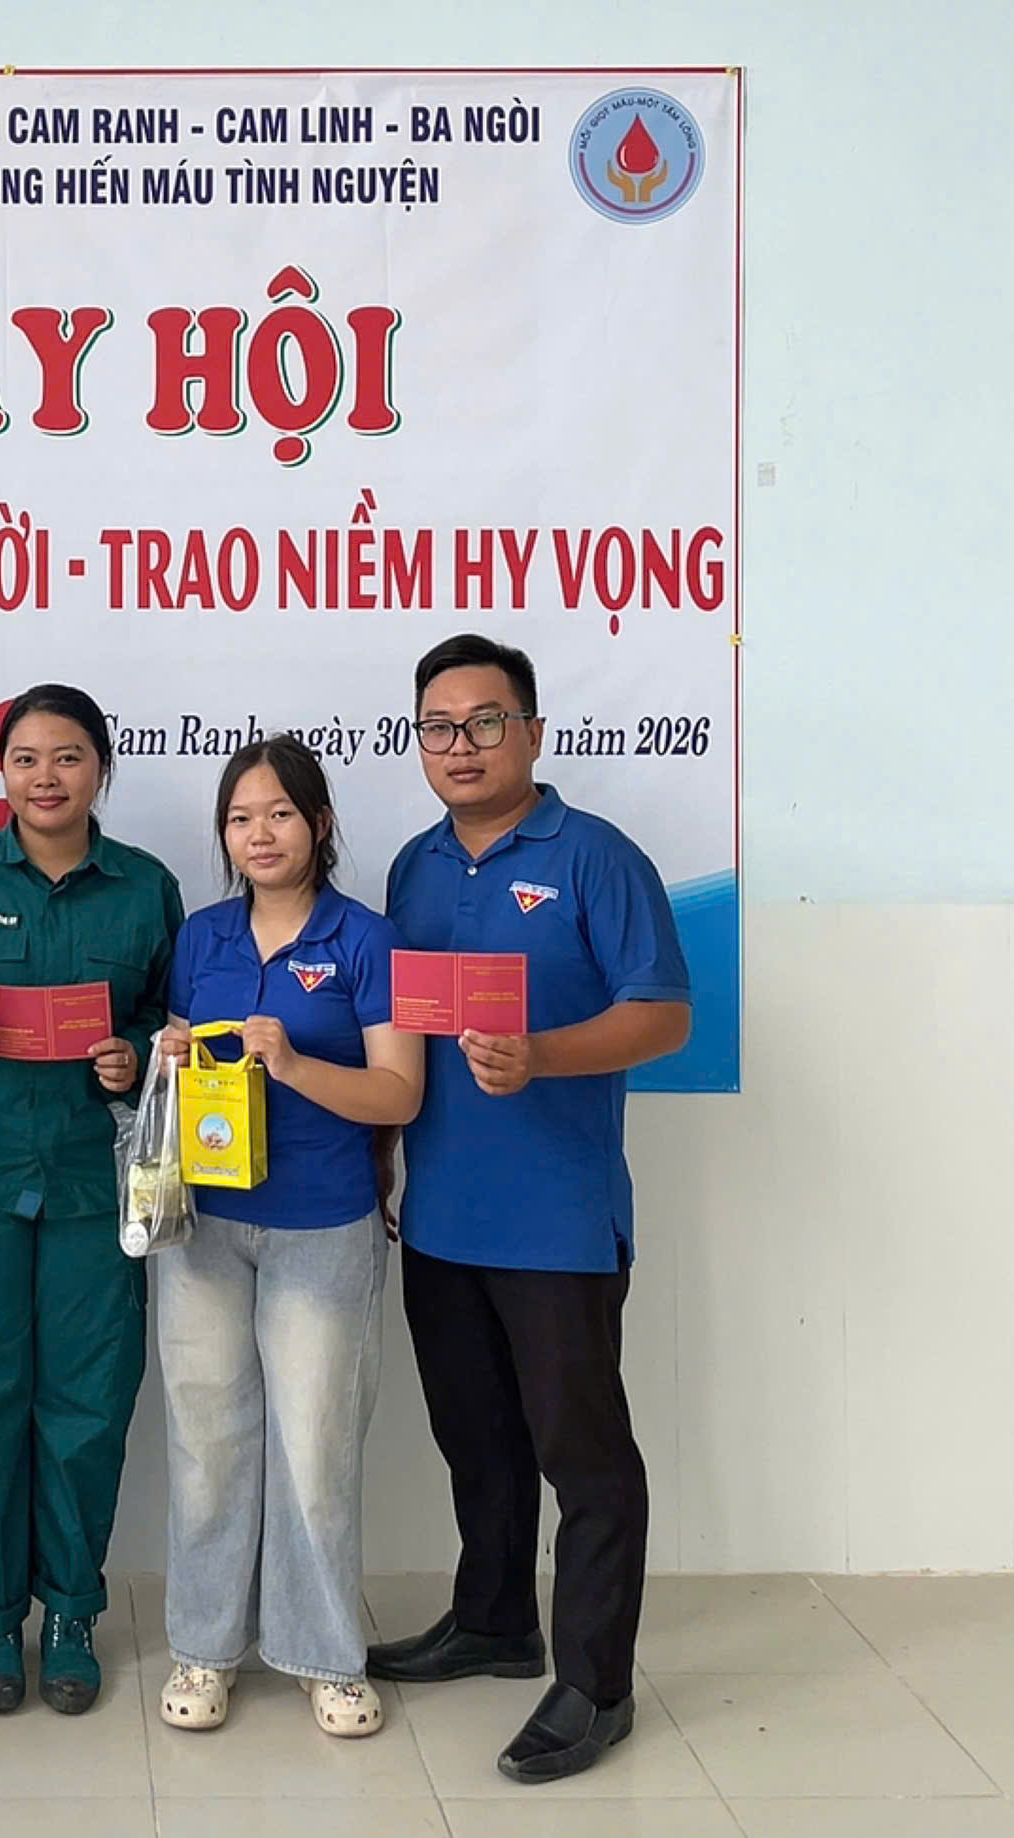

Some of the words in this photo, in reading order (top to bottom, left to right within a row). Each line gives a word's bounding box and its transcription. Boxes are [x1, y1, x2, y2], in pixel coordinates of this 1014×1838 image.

[8, 107, 80, 144] CAM
[92, 107, 178, 144] RANH
[191, 125, 204, 134] -
[216, 107, 288, 144] CAM
[300, 106, 373, 143] LINH
[385, 124, 399, 133] -
[411, 106, 453, 142] BA
[464, 96, 540, 143] NGÒI
[55, 154, 129, 205] HIẾN
[142, 158, 214, 205] MÁU
[225, 158, 299, 205] TÌNH
[312, 157, 439, 212] NGUYỆN
[145, 264, 403, 468] HỘI
[68, 559, 86, 577] -
[100, 527, 261, 613] TRAO
[278, 488, 434, 609] NIỀM
[454, 528, 539, 609] HY
[553, 526, 724, 635] VỌNG
[176, 714, 265, 756] Ranh
[372, 716, 411, 757] 30
[553, 715, 626, 757] năm
[633, 716, 711, 757] 2026
